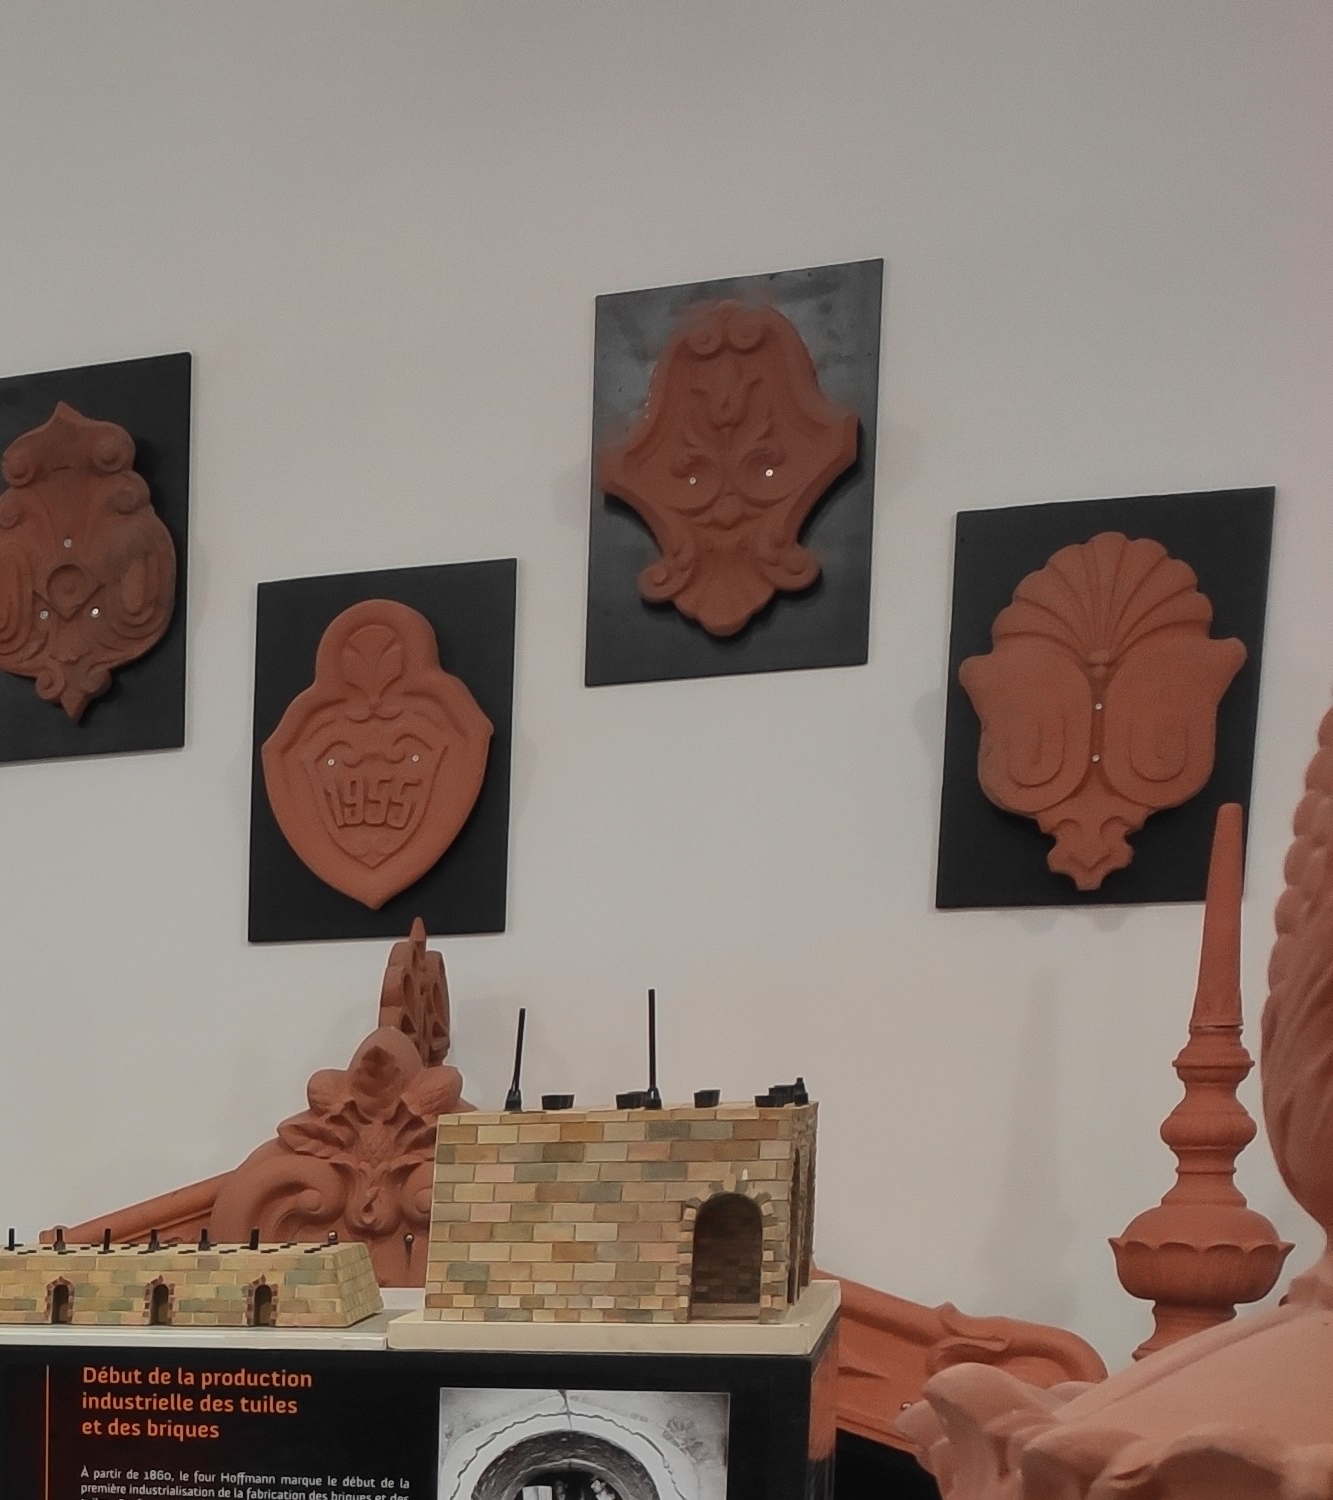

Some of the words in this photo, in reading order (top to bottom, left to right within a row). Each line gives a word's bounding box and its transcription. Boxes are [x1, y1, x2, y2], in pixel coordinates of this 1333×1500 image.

[323, 777, 422, 830] 1955
[83, 1366, 142, 1384] Début
[148, 1367, 171, 1384] de
[177, 1368, 194, 1385] la
[201, 1369, 312, 1390] production
[82, 1392, 193, 1411] industrielle
[199, 1394, 233, 1411] des
[239, 1395, 297, 1413] tuiles
[81, 1418, 102, 1435] et
[107, 1418, 140, 1436] des
[147, 1419, 219, 1442] briques
[80, 1466, 89, 1478] À
[93, 1469, 120, 1480] partir
[126, 1470, 139, 1480] de
[143, 1470, 174, 1482] 1860,
[179, 1471, 189, 1481] le
[193, 1472, 215, 1484] four
[220, 1473, 275, 1485] Hoffmann
[280, 1476, 322, 1487] marque
[327, 1476, 337, 1486] le
[342, 1477, 375, 1487] début
[380, 1478, 394, 1488] de
[399, 1478, 409, 1488] la
[80, 1483, 126, 1494] première
[128, 1484, 215, 1497] industrialisation
[217, 1487, 231, 1497] de
[233, 1488, 243, 1498] la
[246, 1488, 305, 1500] fabrication
[308, 1491, 328, 1500] des
